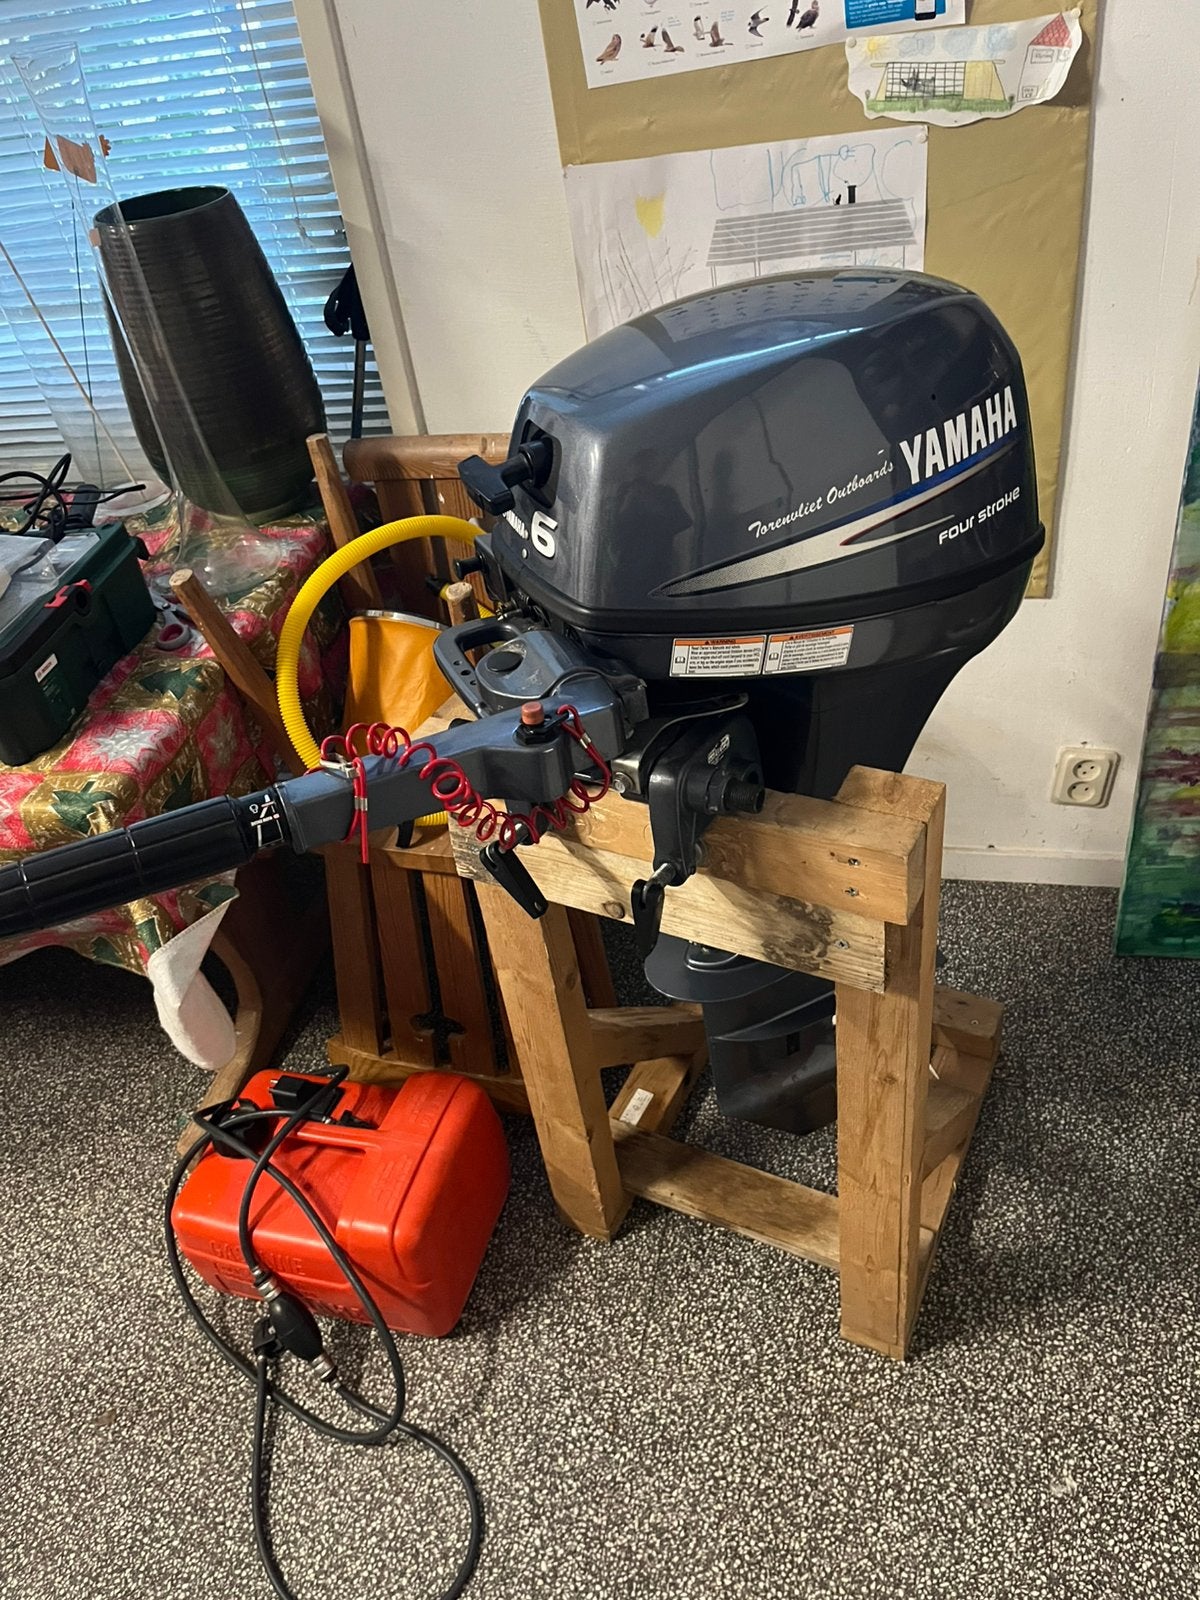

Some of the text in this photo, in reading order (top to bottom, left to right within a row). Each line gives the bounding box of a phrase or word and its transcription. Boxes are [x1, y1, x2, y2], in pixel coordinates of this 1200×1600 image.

[899, 385, 1018, 485] YAMAHA
[530, 510, 559, 558] 6
[748, 460, 894, 539] Torenvliet Outboards
